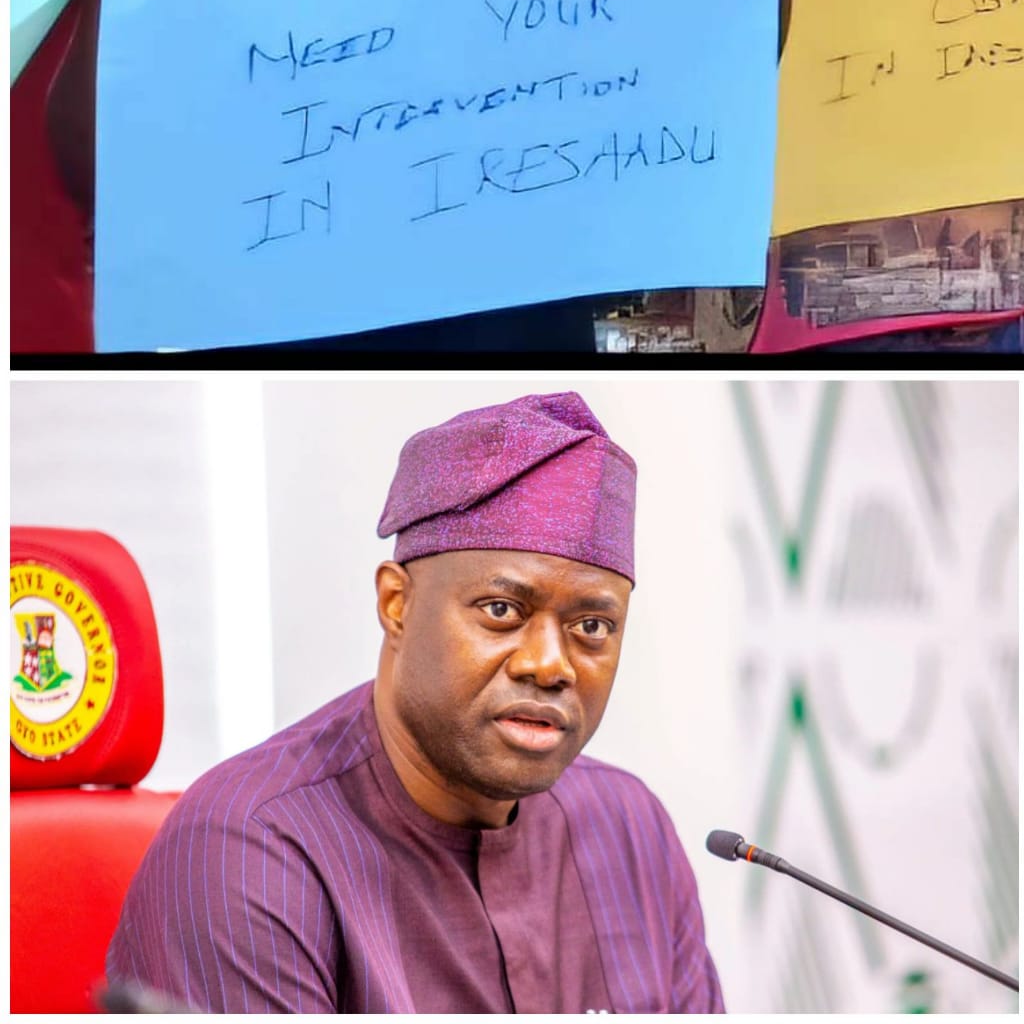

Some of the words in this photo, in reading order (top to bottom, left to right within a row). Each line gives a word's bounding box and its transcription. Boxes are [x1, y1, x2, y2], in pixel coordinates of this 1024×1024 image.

[248, 27, 396, 83] NEED
[822, 51, 896, 105] IN
[242, 181, 332, 251] IN
